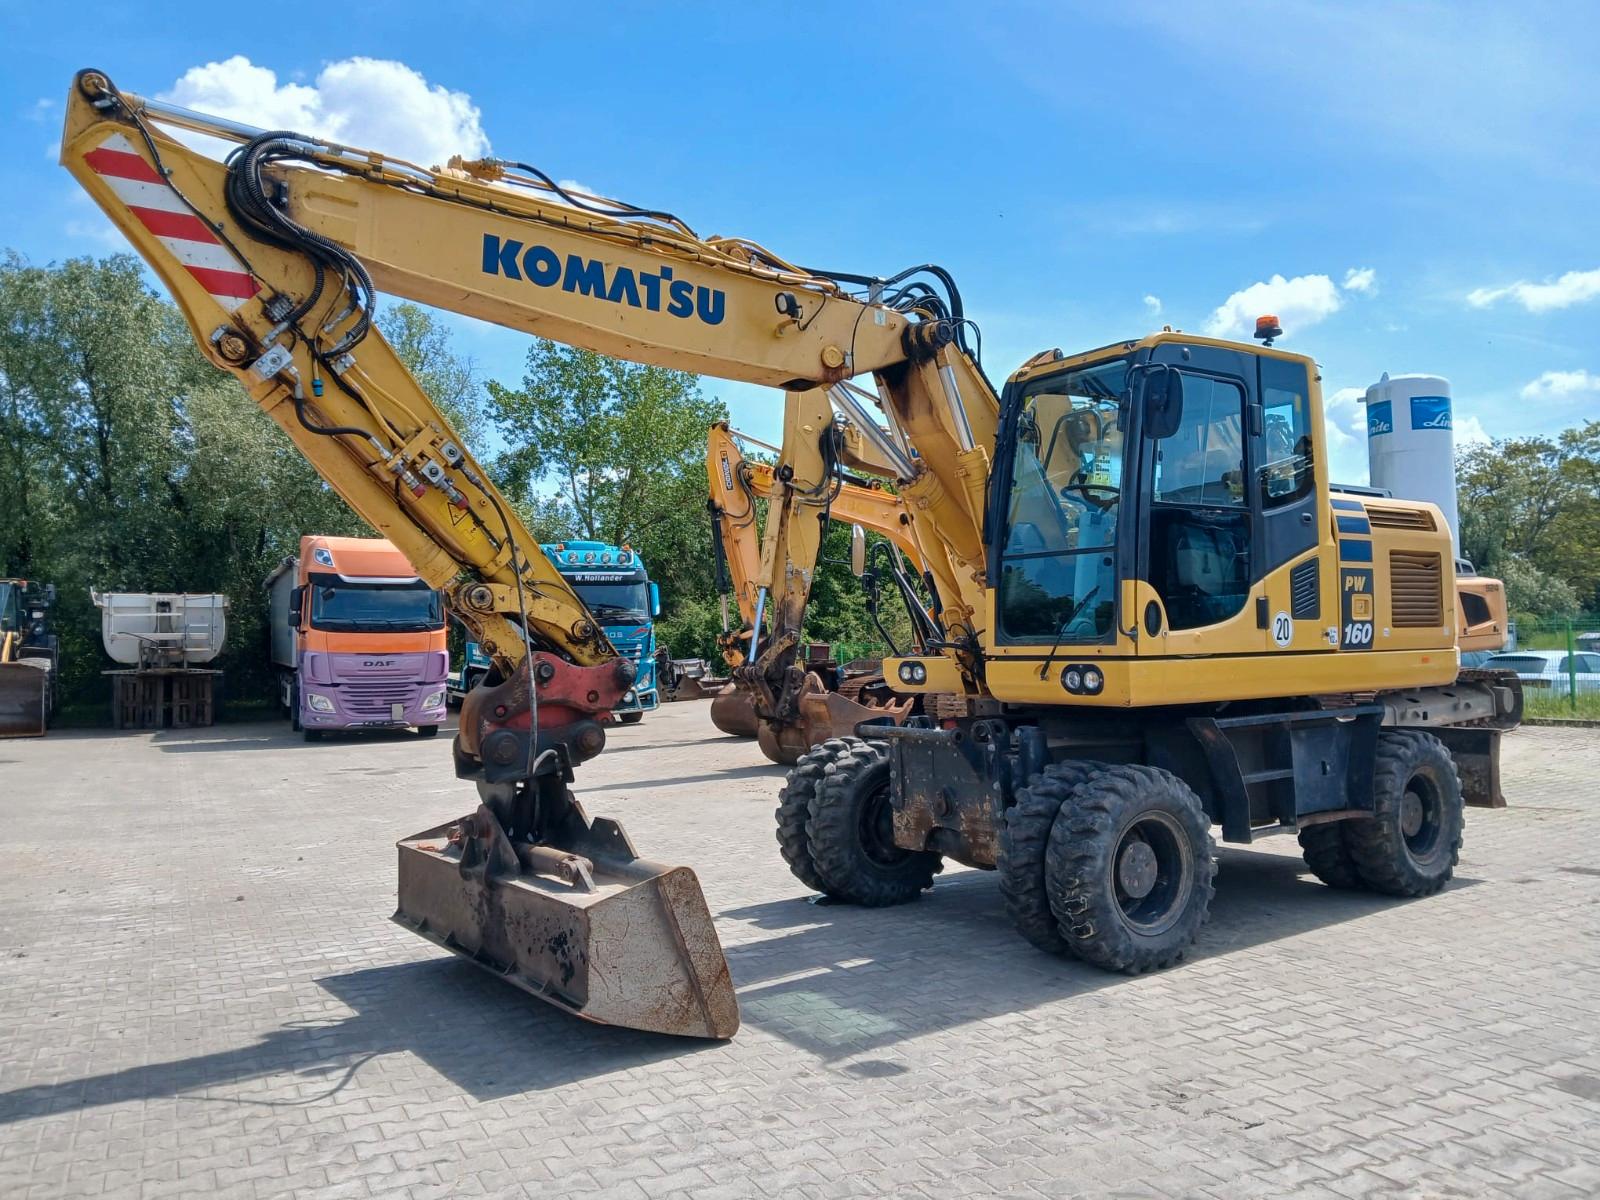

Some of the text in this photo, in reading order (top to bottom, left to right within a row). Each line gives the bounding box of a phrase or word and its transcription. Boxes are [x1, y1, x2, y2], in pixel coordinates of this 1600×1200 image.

[482, 233, 725, 325] KOMATSU
[1345, 576, 1366, 591] PW
[1276, 618, 1290, 640] 20
[1345, 623, 1373, 644] 160
